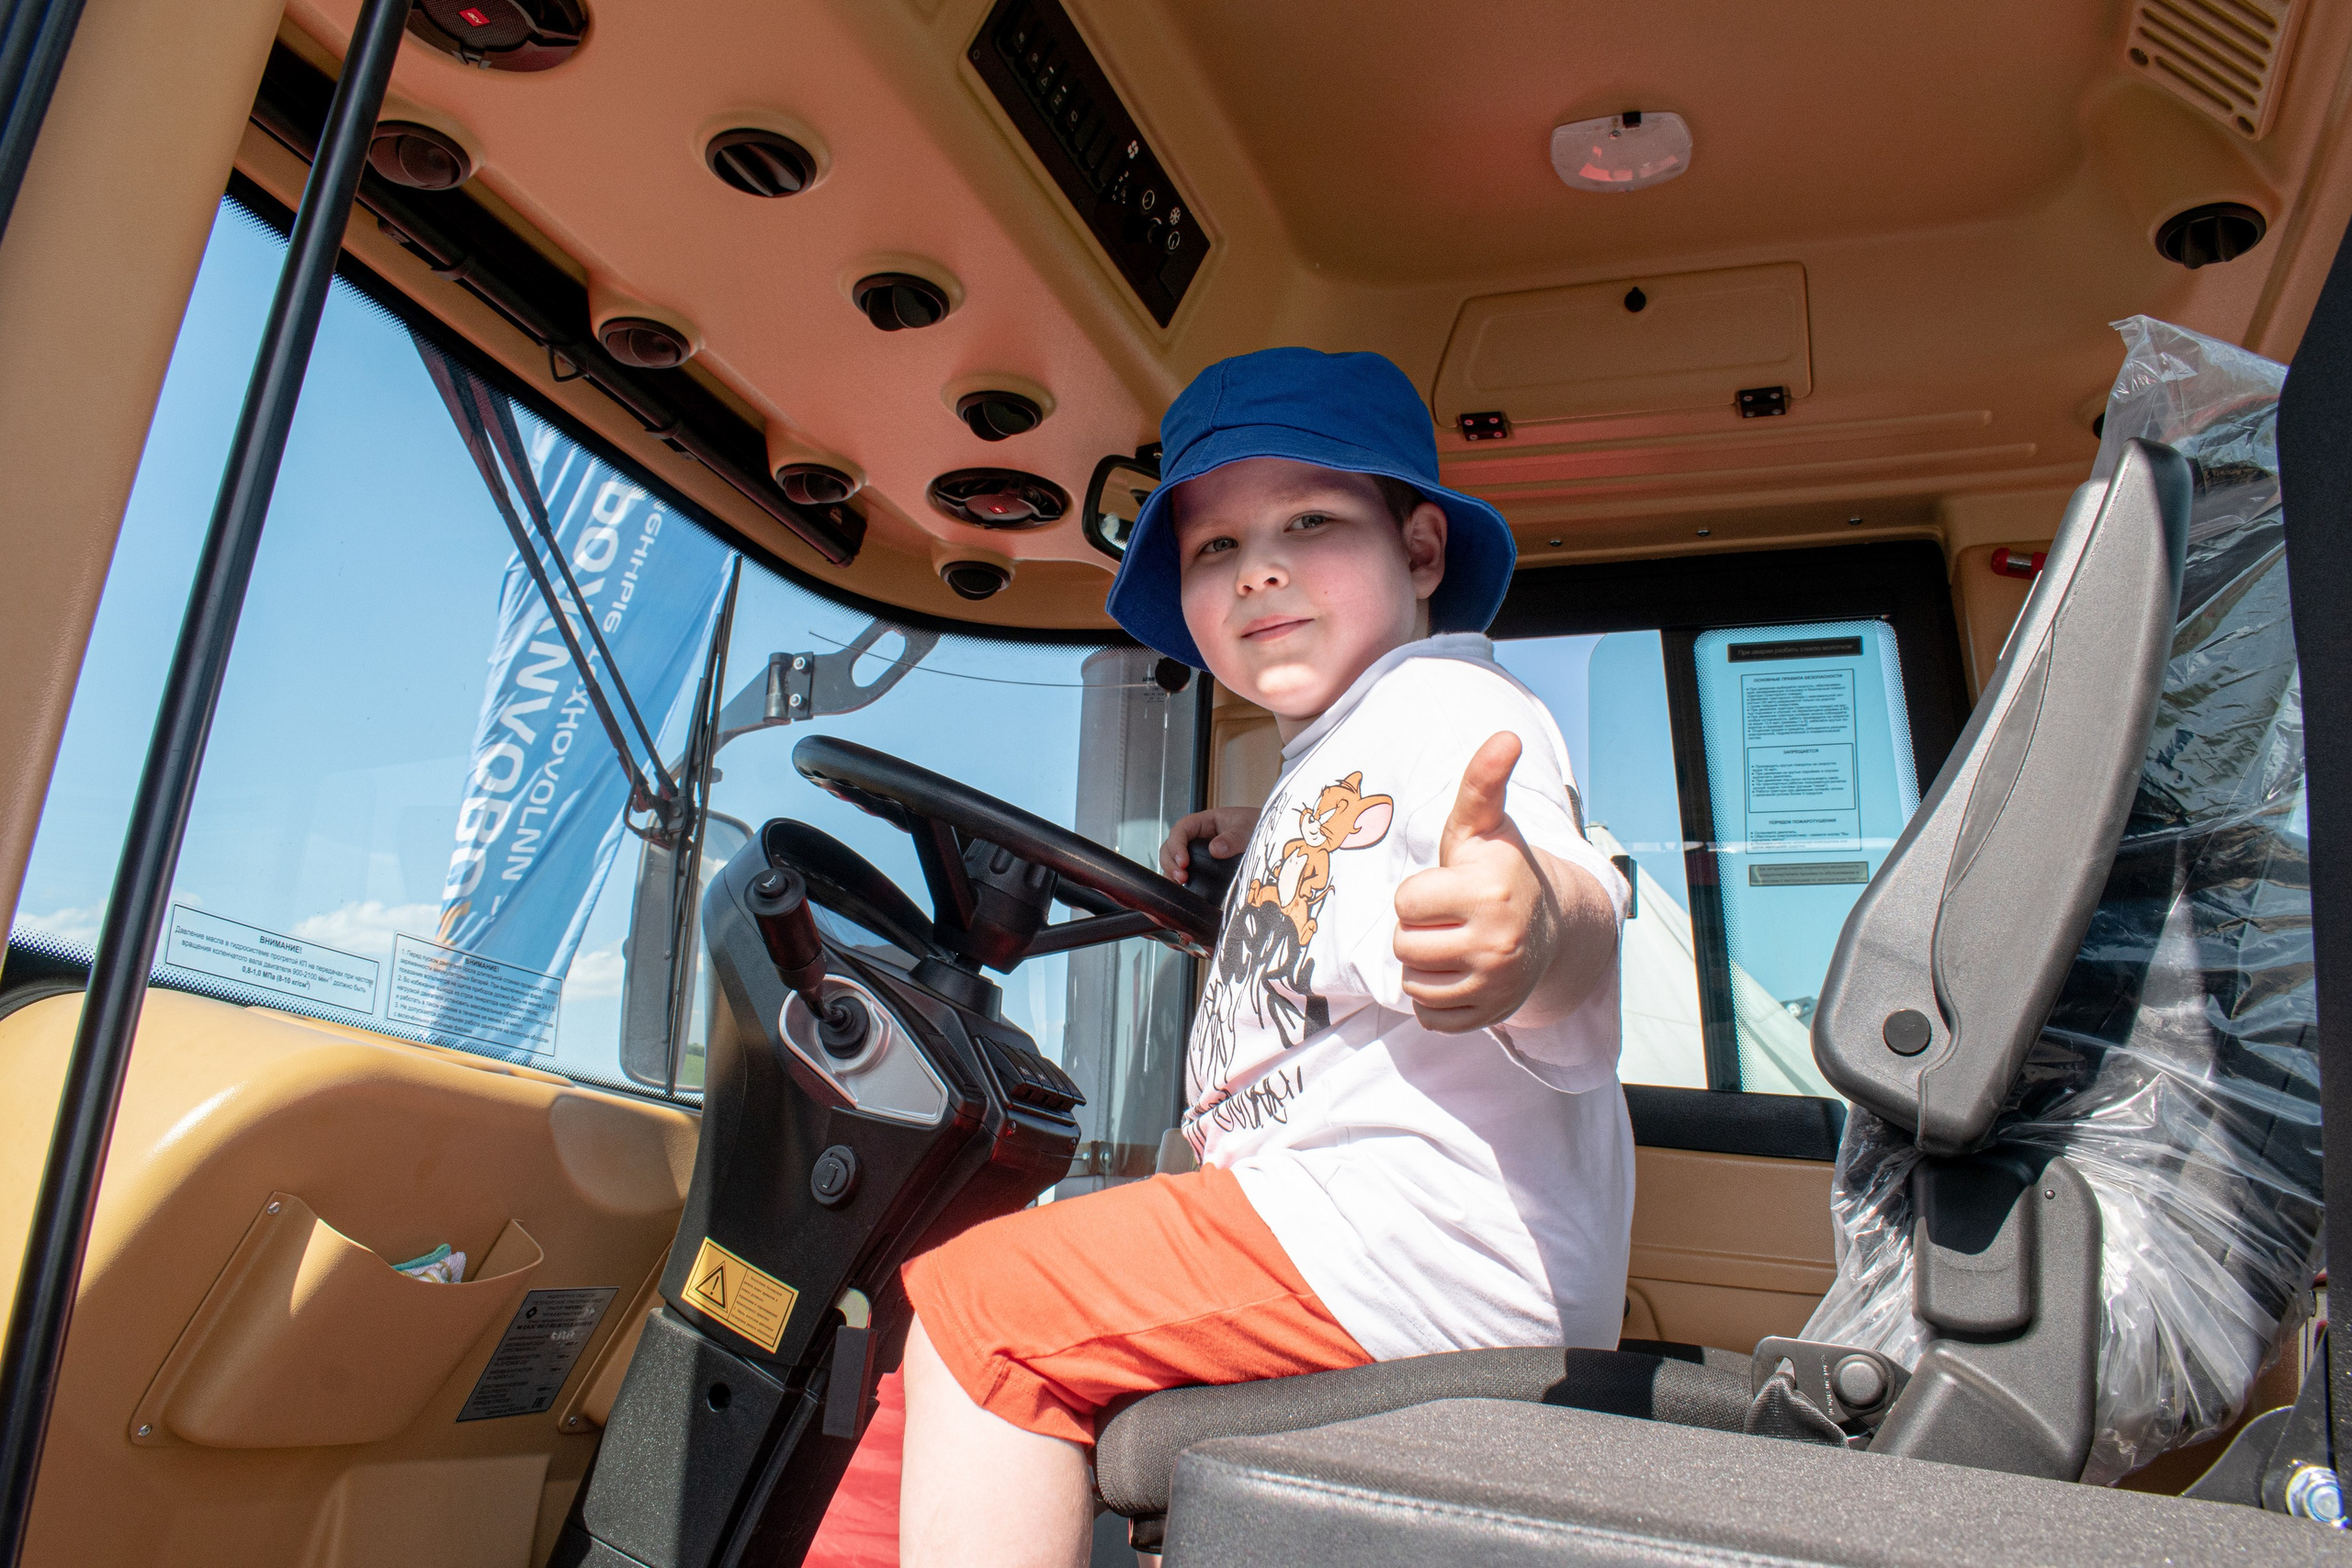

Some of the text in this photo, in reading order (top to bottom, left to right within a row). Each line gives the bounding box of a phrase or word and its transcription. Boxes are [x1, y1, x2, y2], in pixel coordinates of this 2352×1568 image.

[175, 925, 204, 940] Давление
[206, 935, 224, 944] масла
[230, 942, 269, 957] гидросистеме
[270, 953, 298, 965] прогретой
[316, 965, 343, 977] передачах
[260, 935, 302, 954] ВНИМАНИЕ!
[182, 940, 211, 953] вращения
[212, 948, 247, 963] коленчатого
[249, 957, 263, 965] вала
[263, 961, 291, 975] двигателя
[292, 968, 317, 980] 900-2100
[333, 979, 353, 990] должно
[354, 985, 367, 993] быть
[466, 958, 499, 971] ВНИМАНИЕ!
[242, 965, 262, 977] 0,8-1,0
[262, 971, 275, 980] МПа
[277, 975, 290, 985] (8-10
